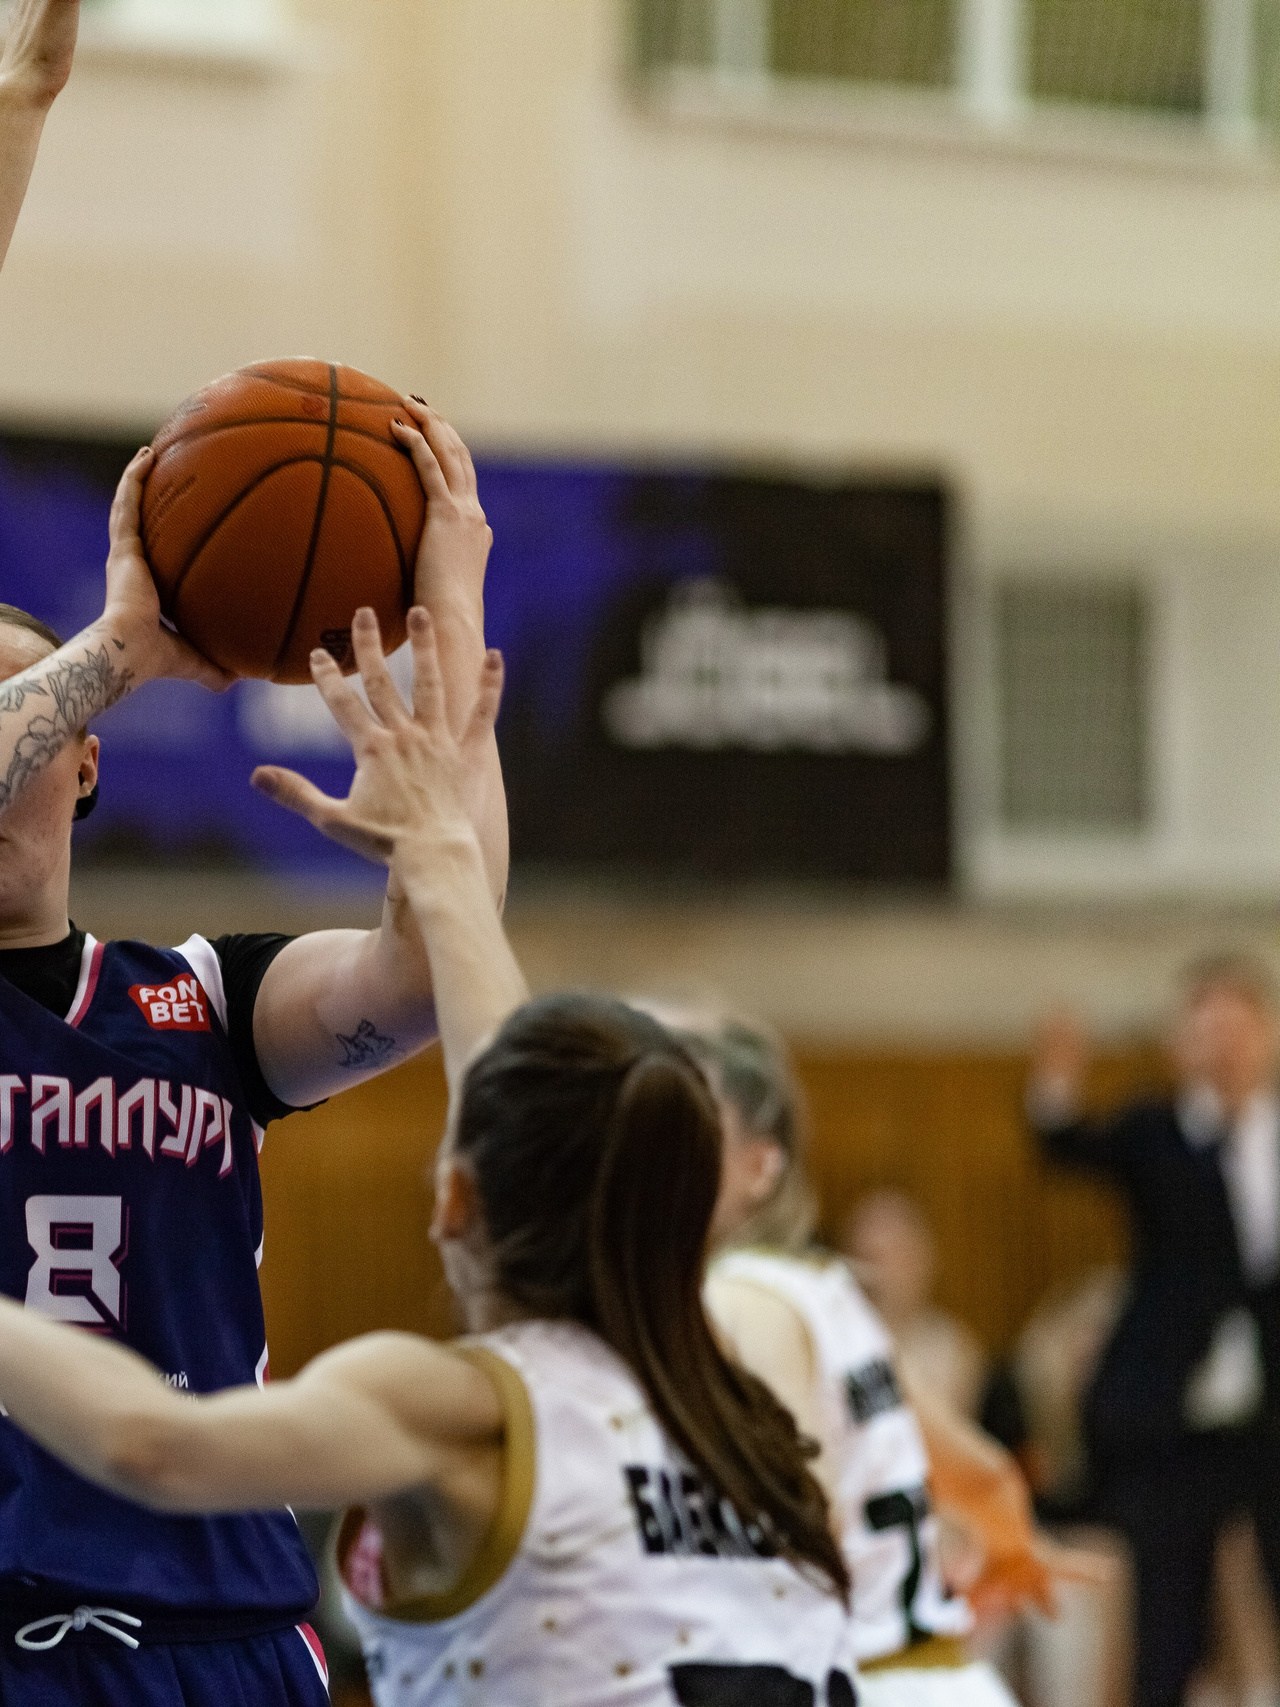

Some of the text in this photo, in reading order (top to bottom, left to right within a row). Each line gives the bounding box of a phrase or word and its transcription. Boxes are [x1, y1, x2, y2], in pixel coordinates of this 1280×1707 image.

[139, 979, 198, 1004] FON
[150, 1000, 204, 1023] BET
[25, 1194, 130, 1333] 8
